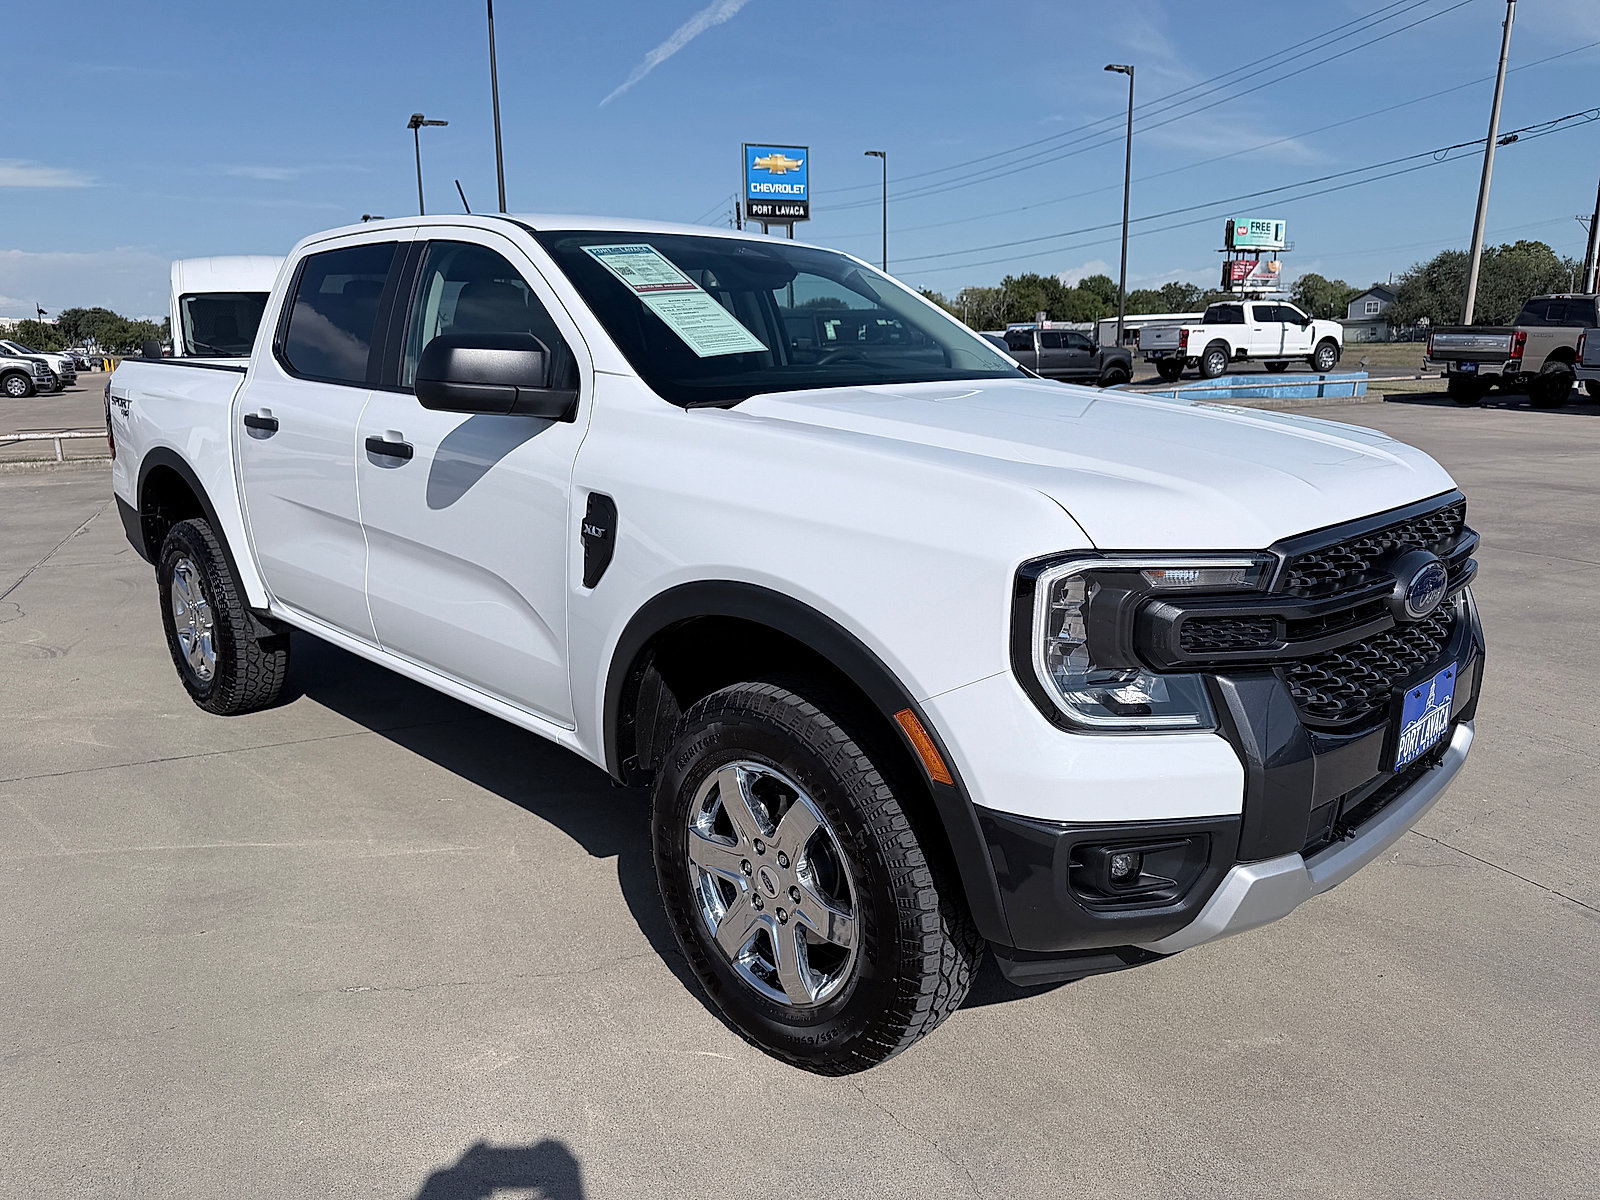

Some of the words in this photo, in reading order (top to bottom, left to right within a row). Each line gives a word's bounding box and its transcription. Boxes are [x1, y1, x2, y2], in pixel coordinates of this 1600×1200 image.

[751, 183, 805, 193] CHEVROLET
[752, 205, 772, 215] PORT
[776, 206, 804, 216] LAVACA
[1250, 221, 1271, 231] FREE
[111, 396, 132, 409] SPORT
[583, 523, 606, 538] XLT
[1398, 727, 1421, 762] PORT
[1420, 706, 1450, 744] LAVACA
